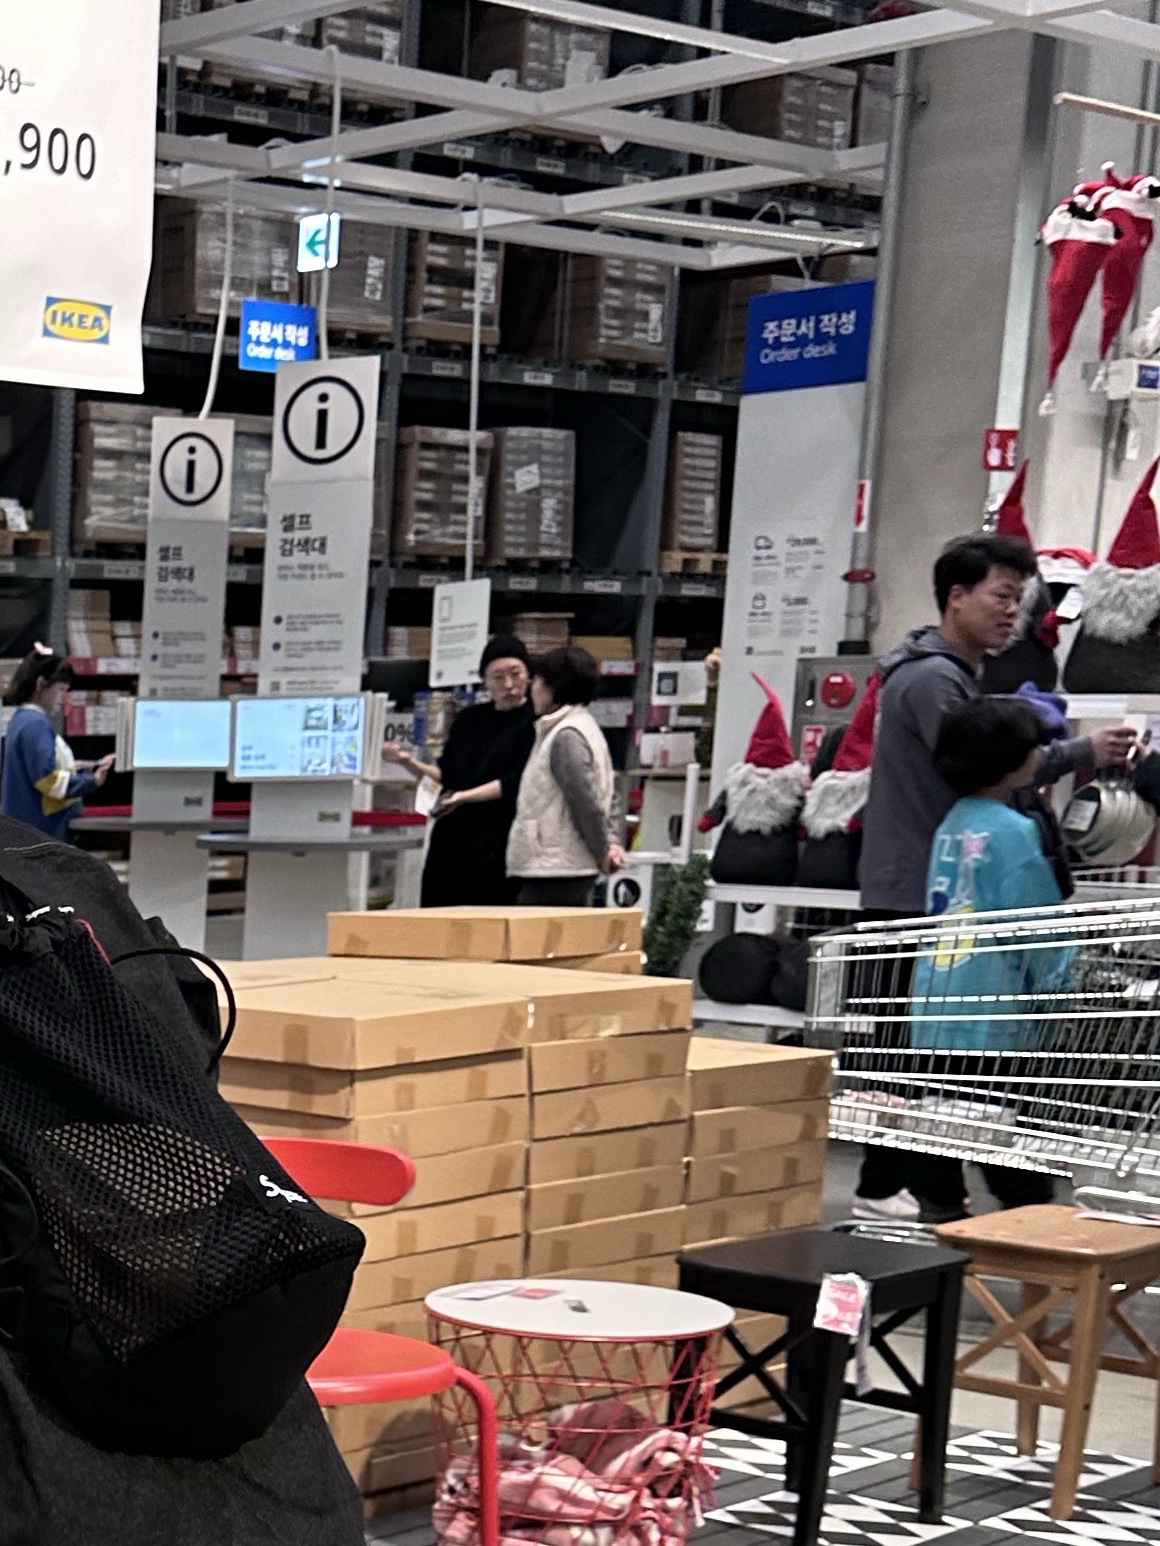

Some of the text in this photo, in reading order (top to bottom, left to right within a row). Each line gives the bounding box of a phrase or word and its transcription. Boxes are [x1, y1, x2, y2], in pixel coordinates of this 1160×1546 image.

[49, 309, 105, 332] IKEA
[762, 309, 857, 345] 주문서 작성
[247, 319, 310, 347] 주문서 작성
[759, 347, 801, 364] Order
[280, 513, 312, 533] 셀프
[279, 536, 328, 557] 검색대
